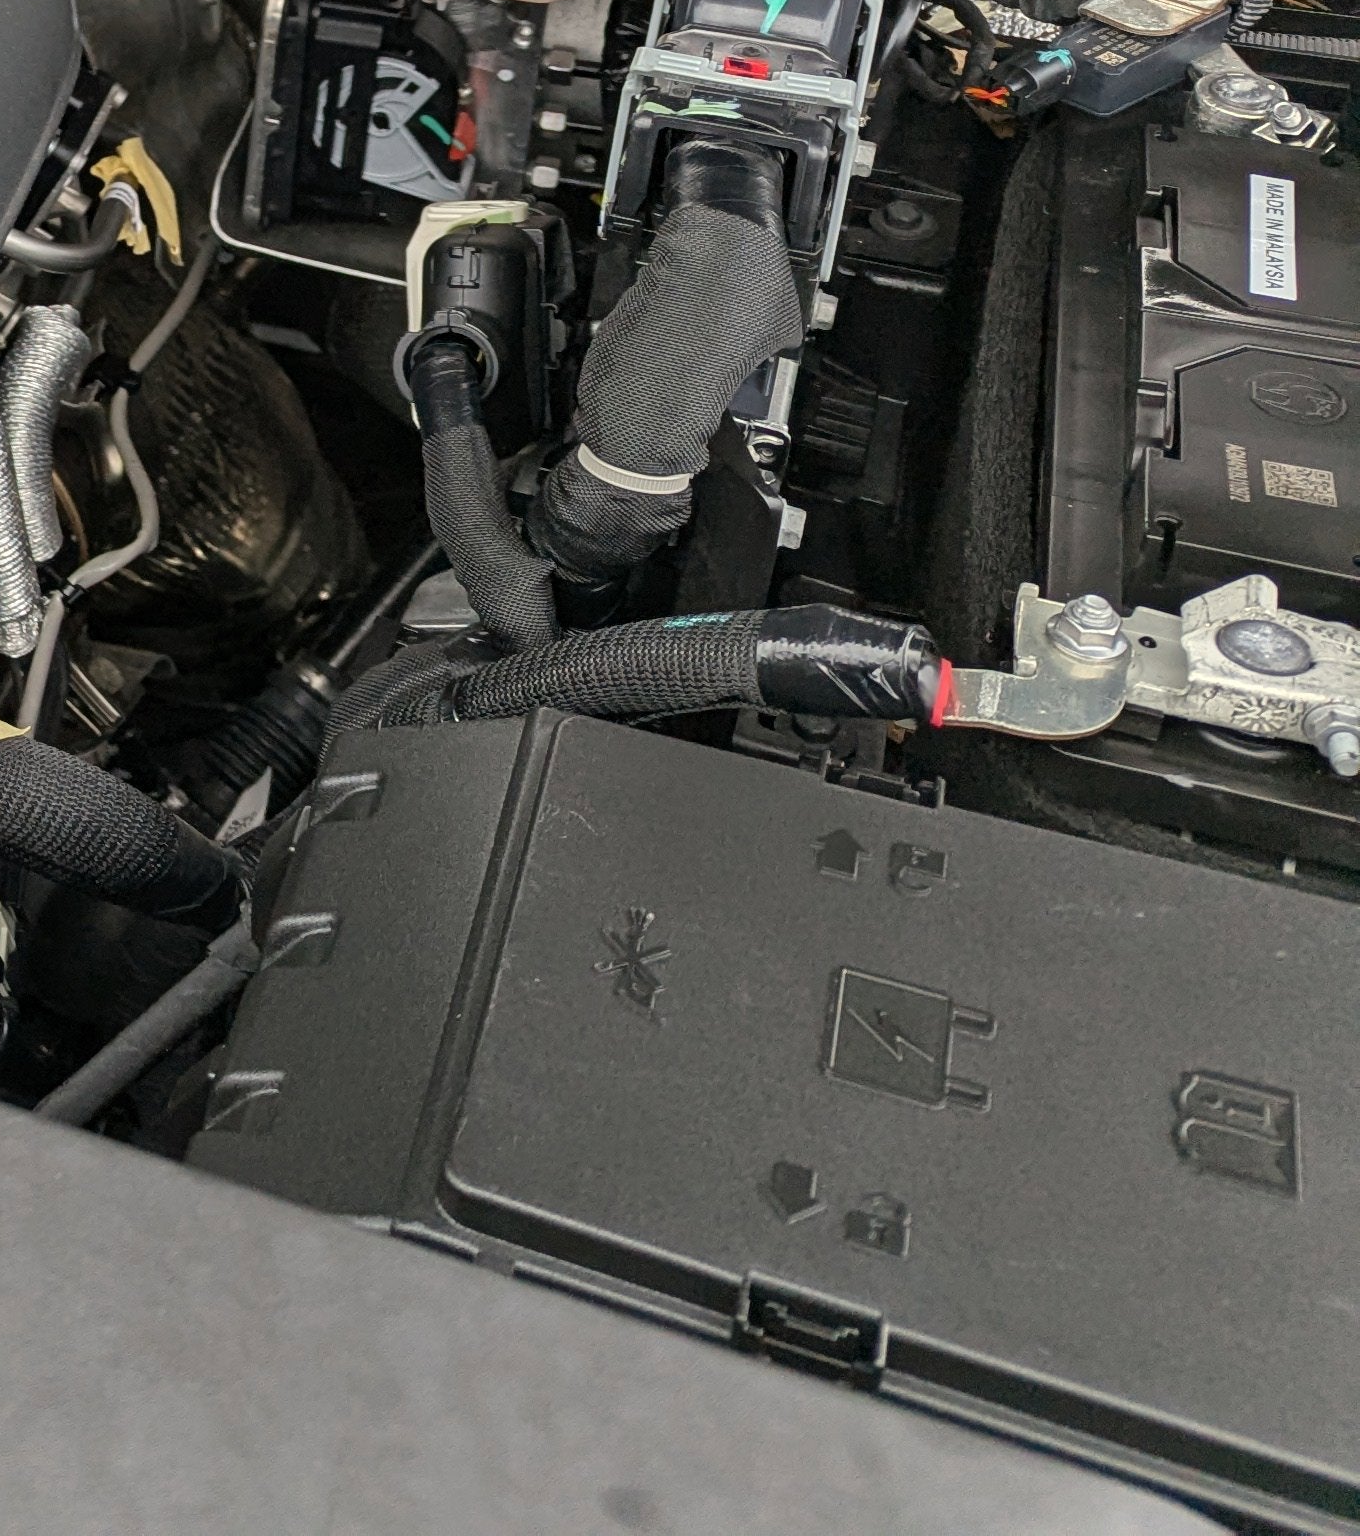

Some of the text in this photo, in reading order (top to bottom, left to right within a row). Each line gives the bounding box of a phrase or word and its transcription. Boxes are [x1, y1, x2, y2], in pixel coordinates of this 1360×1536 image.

[1265, 183, 1284, 289] MADE IN MALAYSIA
